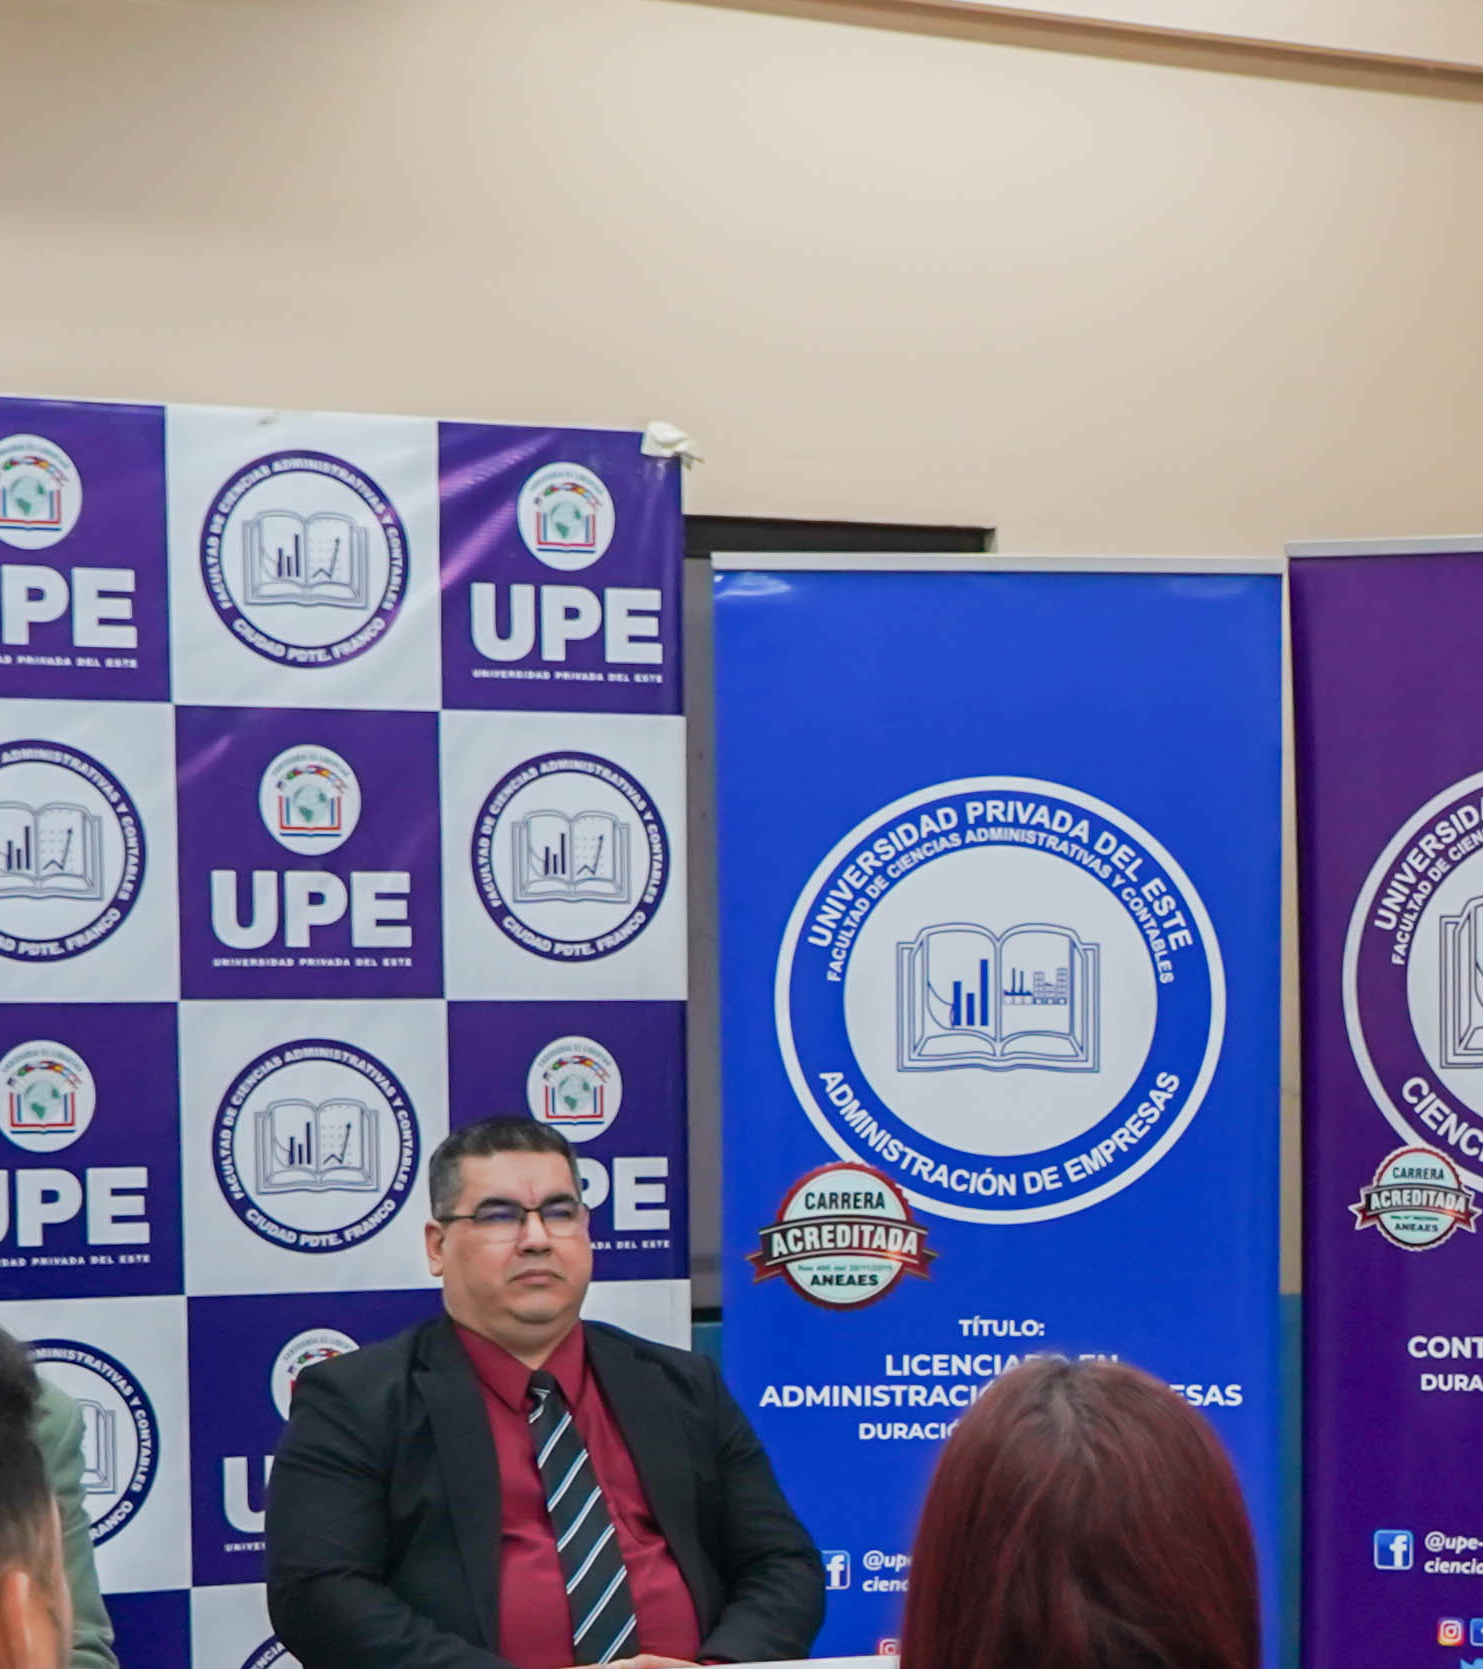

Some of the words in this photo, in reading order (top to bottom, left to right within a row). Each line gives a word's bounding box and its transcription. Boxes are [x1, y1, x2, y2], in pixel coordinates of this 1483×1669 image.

[471, 583, 662, 664] UPE
[808, 808, 957, 946] UNIVERSIDAD
[967, 800, 1088, 843] PRIVADA
[1094, 832, 1142, 881] DEL
[1142, 878, 1192, 950] ESTE
[212, 871, 411, 948] UPE
[828, 898, 869, 981] FACULTAD
[866, 876, 888, 898] DE
[888, 834, 961, 877] CIENCIAS
[966, 828, 1112, 878] ADMINISTRATIVAS
[1122, 888, 1173, 983] CONTABLES
[1392, 881, 1432, 967] FACULTAD
[1428, 858, 1451, 881] DE
[820, 1073, 1016, 1195] ADMINISTRACIÓN
[1024, 1167, 1062, 1193] DE
[1064, 1072, 1179, 1182] EMPRESAS
[1393, 1167, 1444, 1180] CARRERA
[805, 1192, 885, 1210] CARRERA
[1370, 1189, 1465, 1212] ACREDITADA
[772, 1224, 918, 1257] ACREDITADA
[810, 1274, 879, 1286] ANEAES
[959, 1316, 1044, 1336] TÍTULO:
[885, 1354, 1068, 1377] LICENCIA
[760, 1380, 995, 1407] ADMINISTRACI
